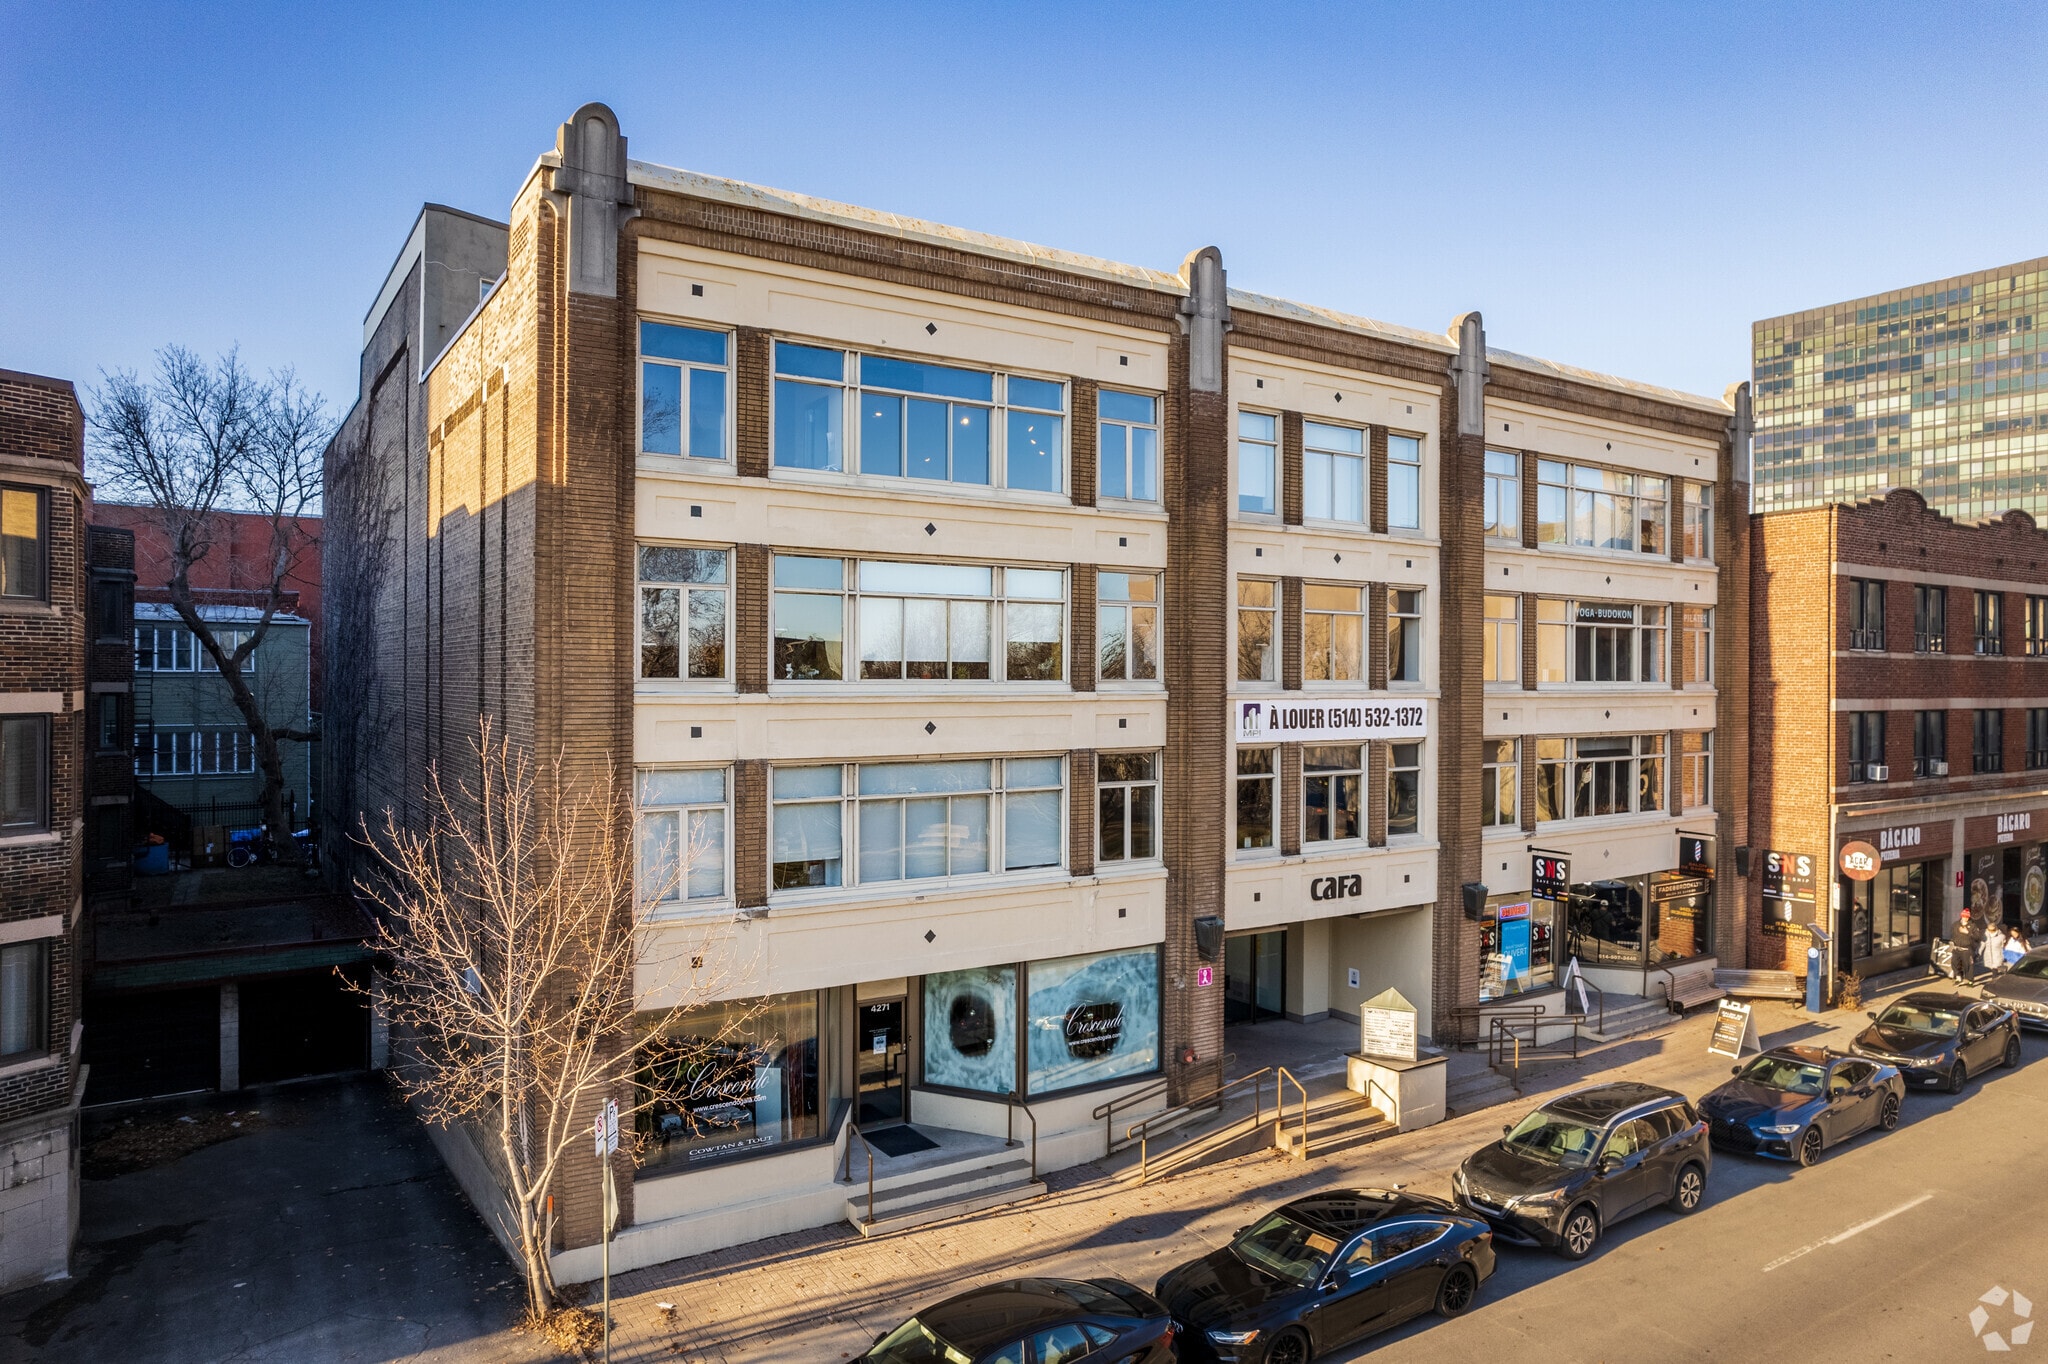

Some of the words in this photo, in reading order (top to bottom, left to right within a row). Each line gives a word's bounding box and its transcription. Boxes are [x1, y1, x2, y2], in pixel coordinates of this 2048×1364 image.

[1684, 614, 1707, 623] PILATES
[1270, 705, 1279, 730] À
[1282, 708, 1325, 730] LOUER
[1328, 707, 1361, 728] (514)
[1365, 706, 1423, 727] 532-1372
[1535, 858, 1566, 880] SNS
[1767, 852, 1811, 877] SNS
[1533, 926, 1550, 940] SNS
[871, 1003, 890, 1012] 4271
[1065, 1003, 1125, 1036] Crescendo
[687, 1061, 771, 1100] Crescendo
[689, 1143, 736, 1156] COWTAN
[746, 1135, 773, 1145] TOUT
